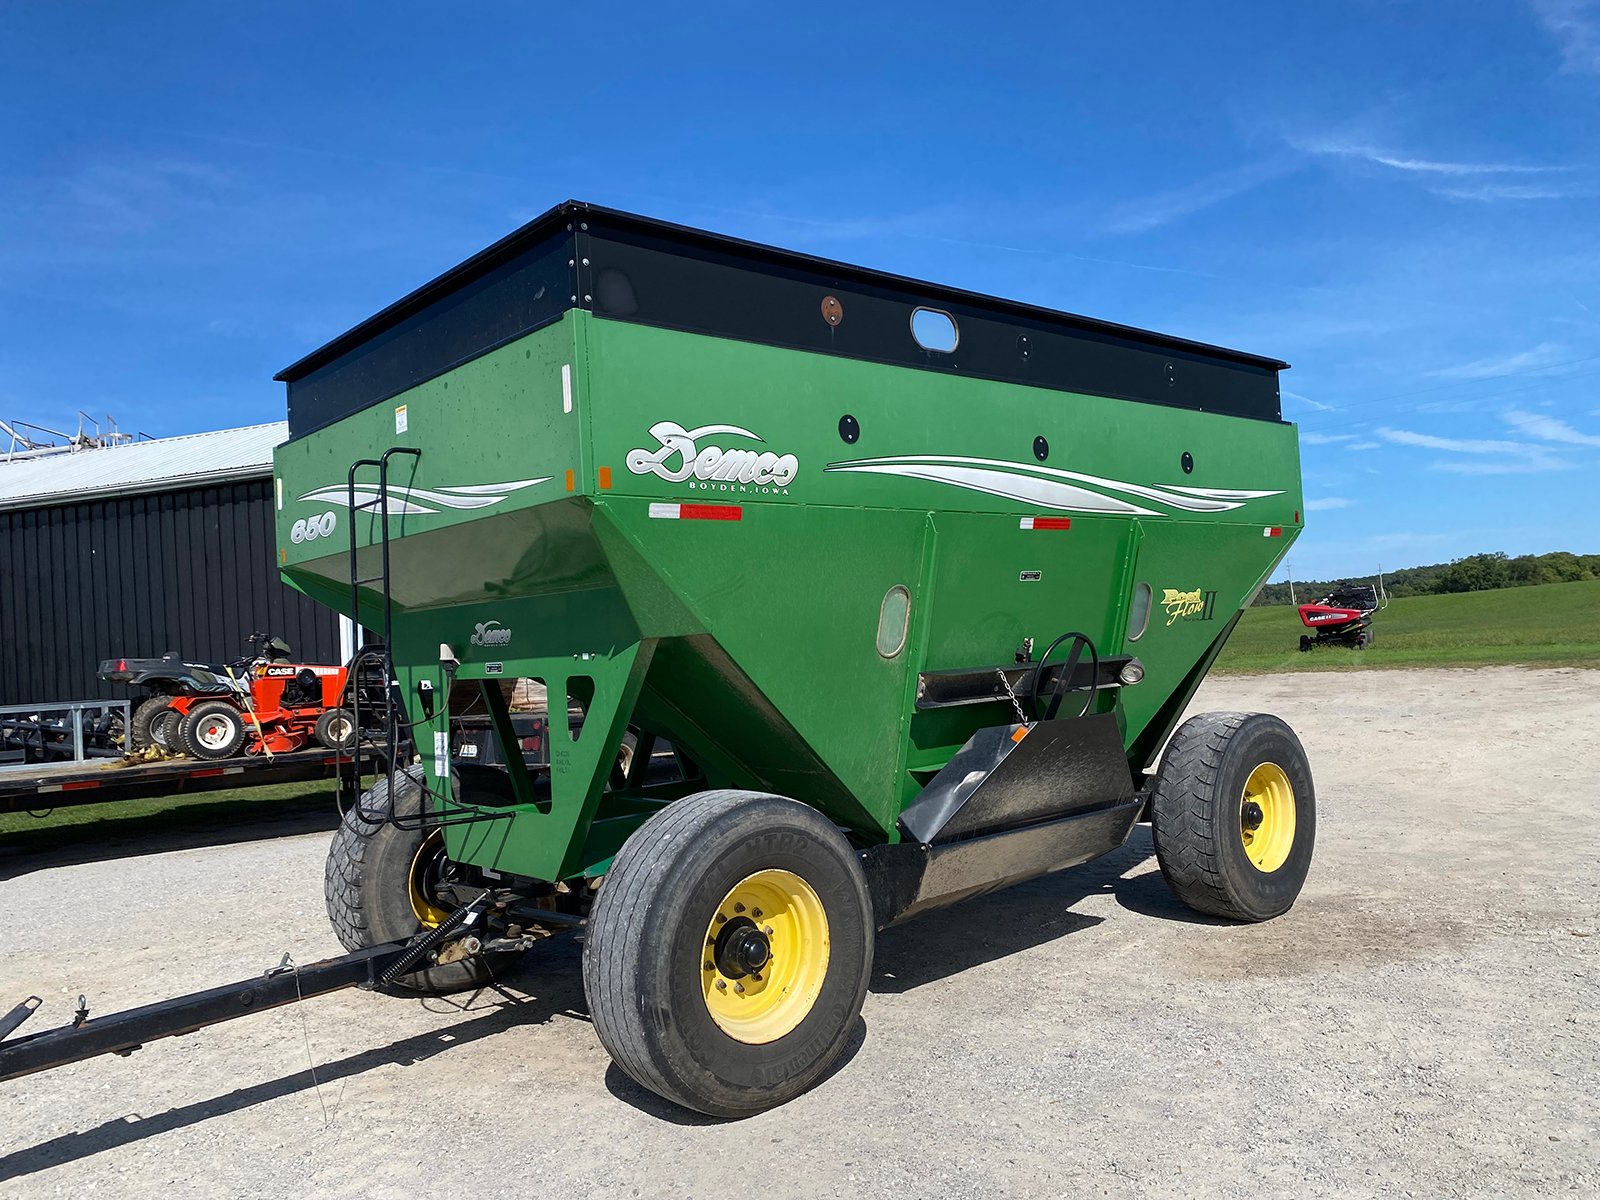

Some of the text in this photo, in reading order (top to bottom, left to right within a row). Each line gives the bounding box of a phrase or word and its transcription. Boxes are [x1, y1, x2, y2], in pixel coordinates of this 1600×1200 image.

[626, 420, 799, 487] Demco
[290, 510, 337, 545] 650
[1166, 600, 1204, 626] Flow
[471, 620, 511, 646] Demco
[268, 667, 294, 676] CASE
